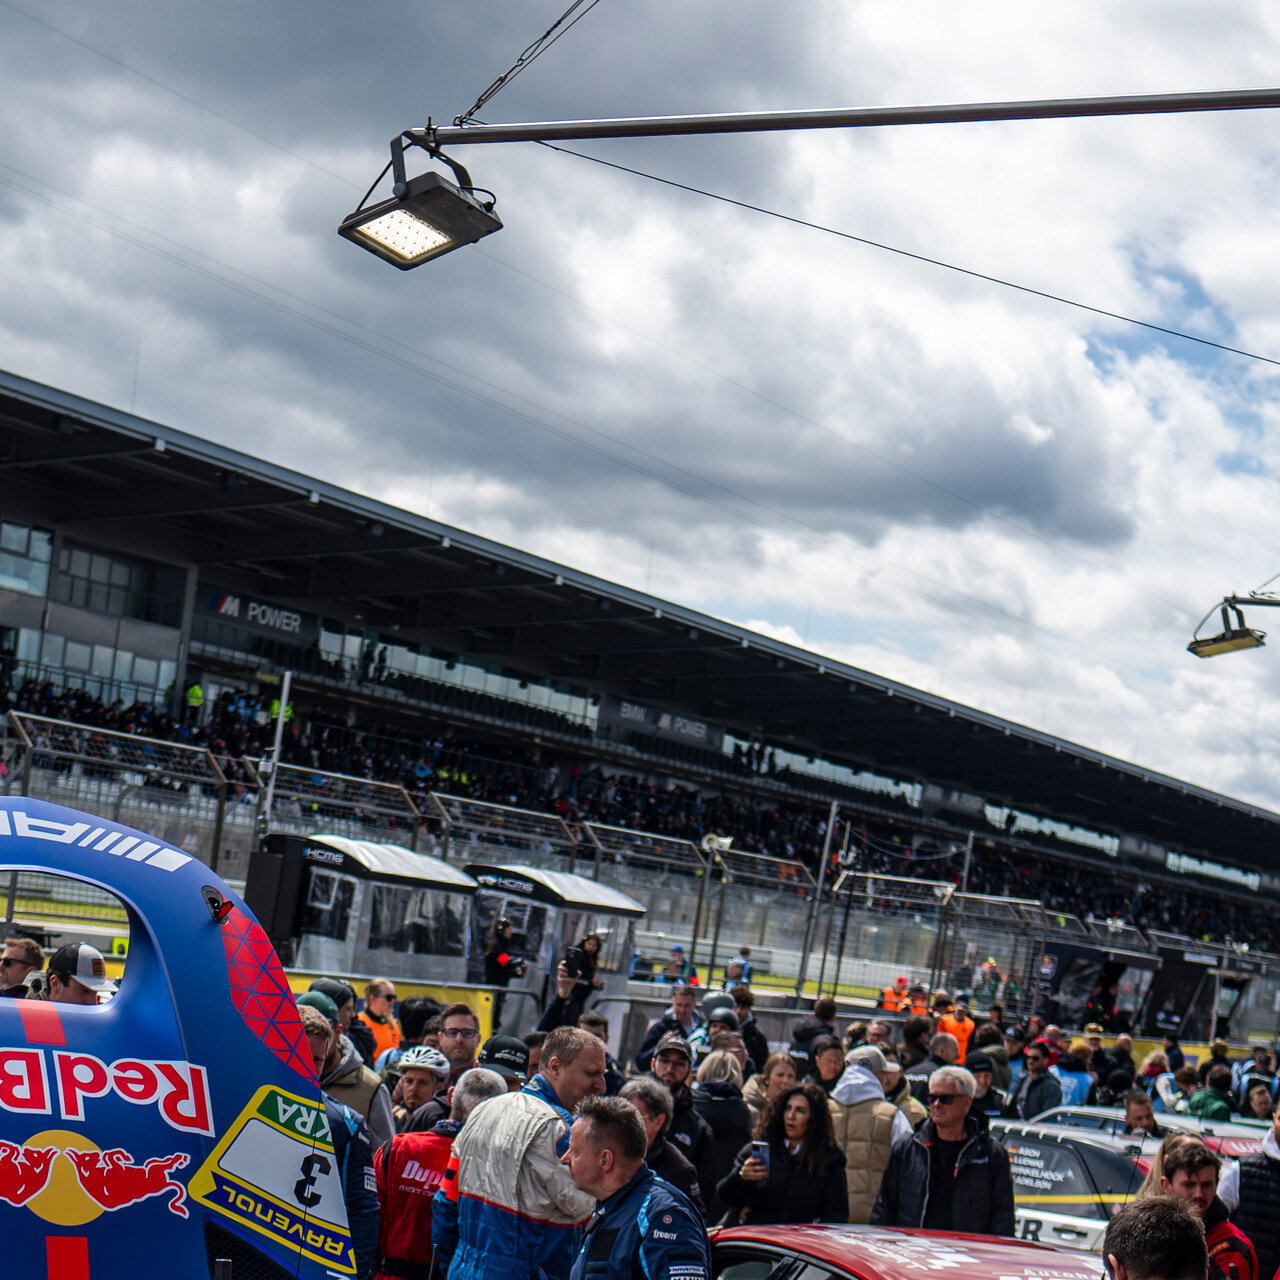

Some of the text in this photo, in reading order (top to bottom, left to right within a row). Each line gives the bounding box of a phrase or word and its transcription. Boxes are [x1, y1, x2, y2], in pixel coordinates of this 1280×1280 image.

[246, 602, 301, 633] POWER
[293, 1153, 332, 1208] 3
[222, 1184, 345, 1256] RAVENOL
[653, 1229, 678, 1240] freem
